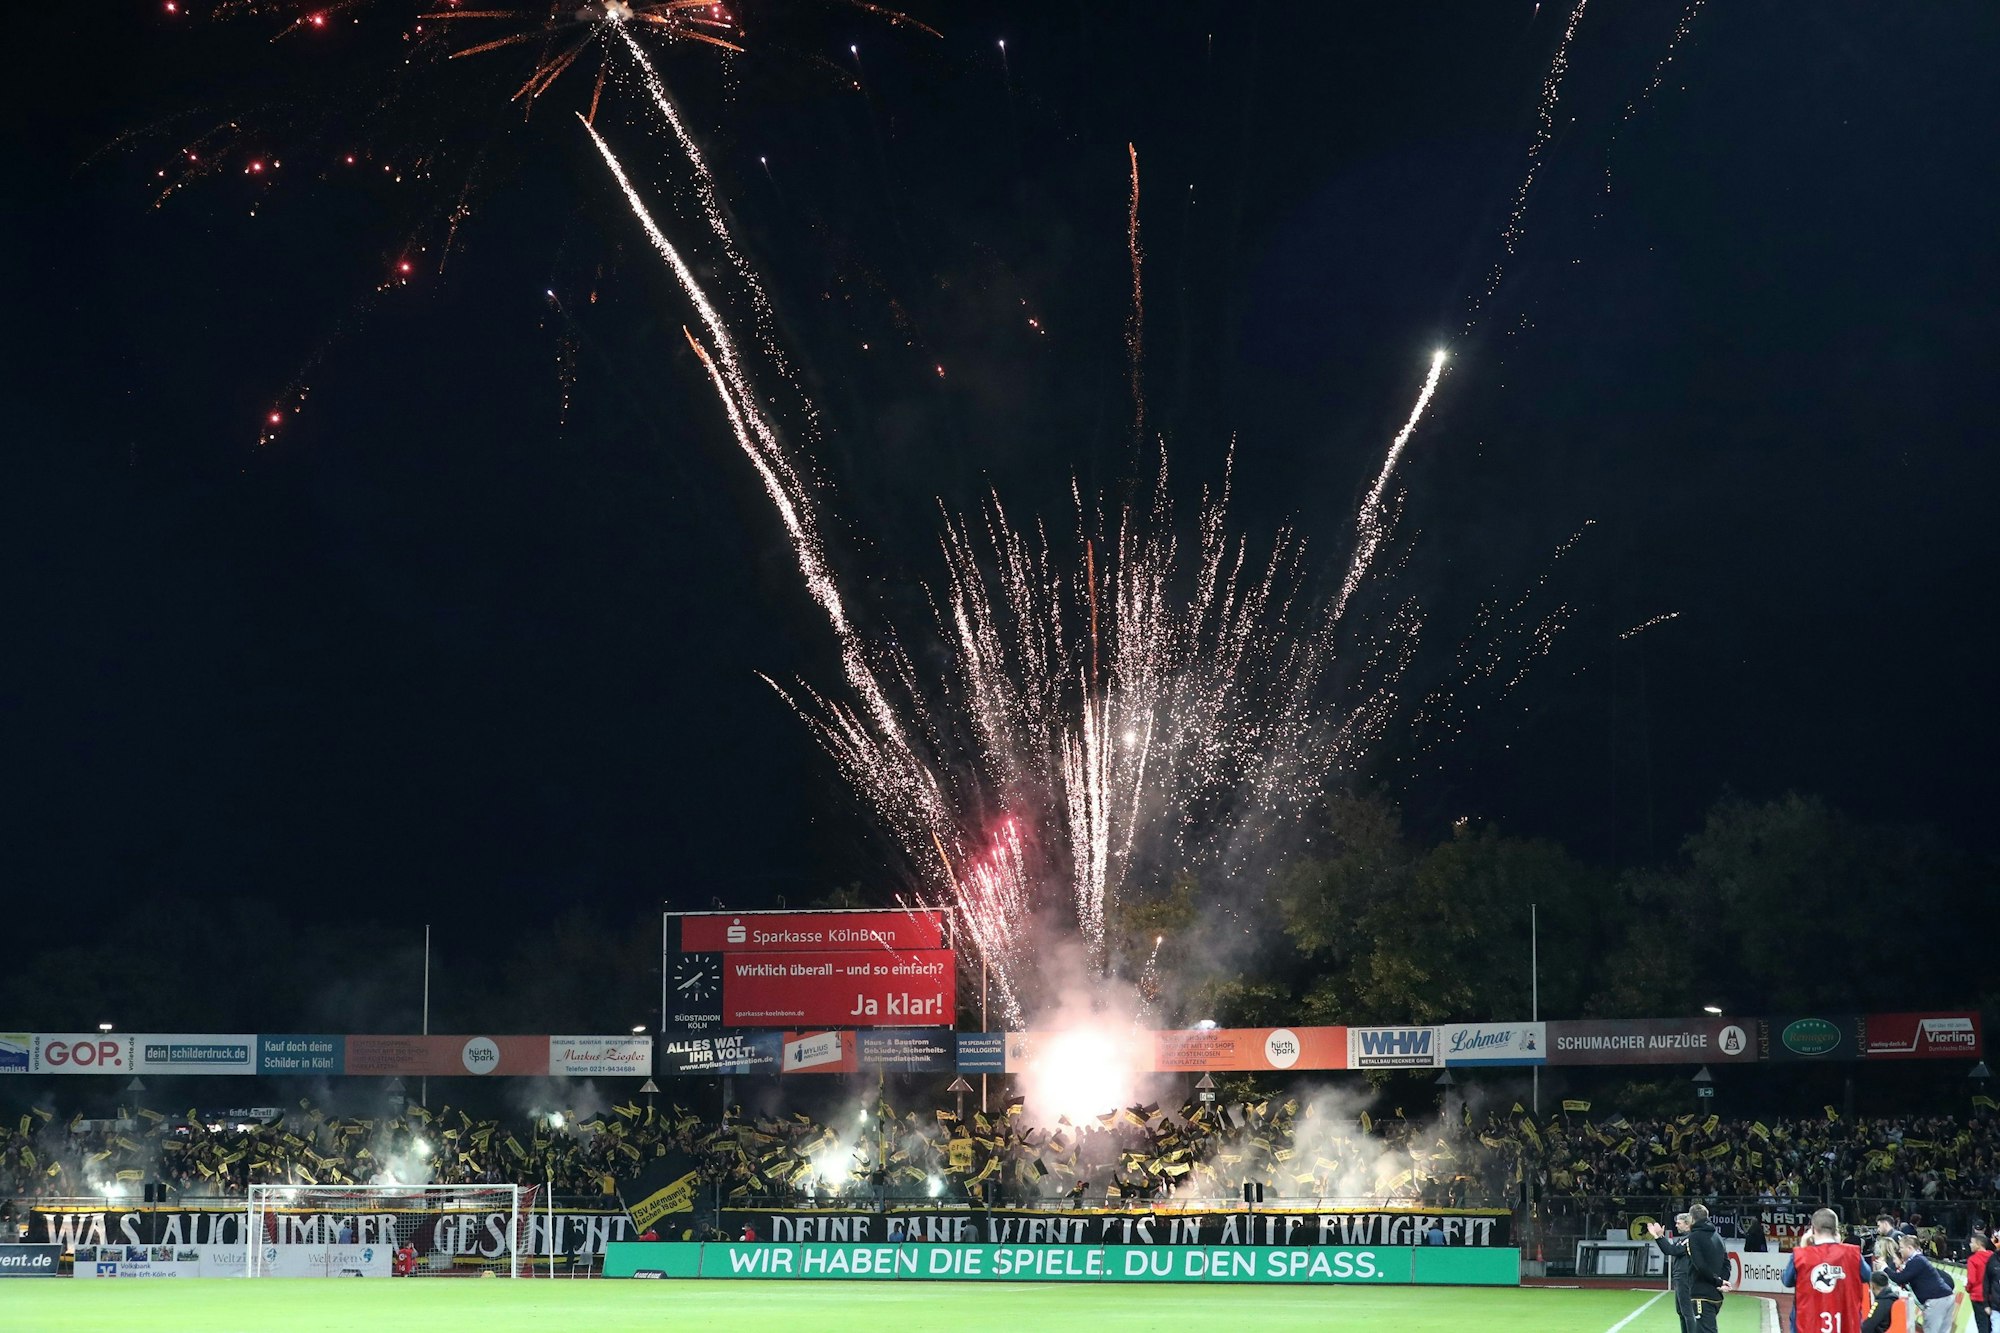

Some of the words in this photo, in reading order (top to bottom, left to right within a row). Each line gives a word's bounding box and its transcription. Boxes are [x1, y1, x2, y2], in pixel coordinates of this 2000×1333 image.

[753, 930, 822, 945] Sparkasse
[828, 928, 896, 942] KölnBonn
[736, 965, 786, 976] Wirklich
[790, 963, 832, 976] überall
[846, 963, 870, 975] und
[874, 966, 888, 975] so
[892, 963, 944, 975] einfach?
[850, 994, 878, 1016] Ja
[887, 993, 943, 1014] klar!
[666, 1039, 710, 1054] ALLES
[714, 1036, 744, 1049] WAT
[1271, 1040, 1292, 1049] hürth
[1361, 1031, 1431, 1054] WHM
[1450, 1029, 1514, 1052] Lohmar
[1557, 1036, 1645, 1050] SCHUMACHER
[1648, 1033, 1707, 1049] AUFZÜGE
[1789, 1032, 1834, 1042] Remagen
[1926, 1032, 1975, 1046] Vierling
[45, 1041, 122, 1066] GOP.
[148, 1047, 166, 1058] dein
[172, 1047, 245, 1058] schilderdruck.de
[265, 1041, 284, 1052] Kauf
[286, 1041, 307, 1052] doch
[309, 1041, 332, 1052] deine
[689, 1051, 713, 1063] IHR
[717, 1046, 756, 1060] VOLT!
[804, 1044, 828, 1054] MYLIUS
[1276, 1048, 1295, 1056] park
[264, 1057, 299, 1068] Schilder
[301, 1057, 309, 1068] in
[312, 1057, 334, 1068] Köln!
[564, 1048, 600, 1060] Markus
[604, 1048, 644, 1063] Ziegler
[680, 1056, 773, 1071] www.mylius-innovation.de
[0, 1064, 27, 1072] anius
[633, 1206, 650, 1219] TSV
[649, 1186, 686, 1210] Alemannia
[637, 1209, 661, 1226] Aachen
[661, 1201, 678, 1211] 1900
[1709, 1215, 1734, 1224] chool
[43, 1210, 142, 1252] WAS
[1170, 1216, 1203, 1243] IN
[213, 1252, 260, 1263] Weltzin
[729, 1248, 793, 1273] WIR
[804, 1248, 918, 1273] HABEN
[929, 1249, 983, 1274] DIE
[992, 1249, 1112, 1276] SPIELE.
[1125, 1250, 1174, 1276] DU
[1185, 1251, 1256, 1277] DEN
[1267, 1252, 1384, 1278] SPASS.
[1744, 1264, 1784, 1280] RheinEner
[1820, 1312, 1841, 1333] 31
